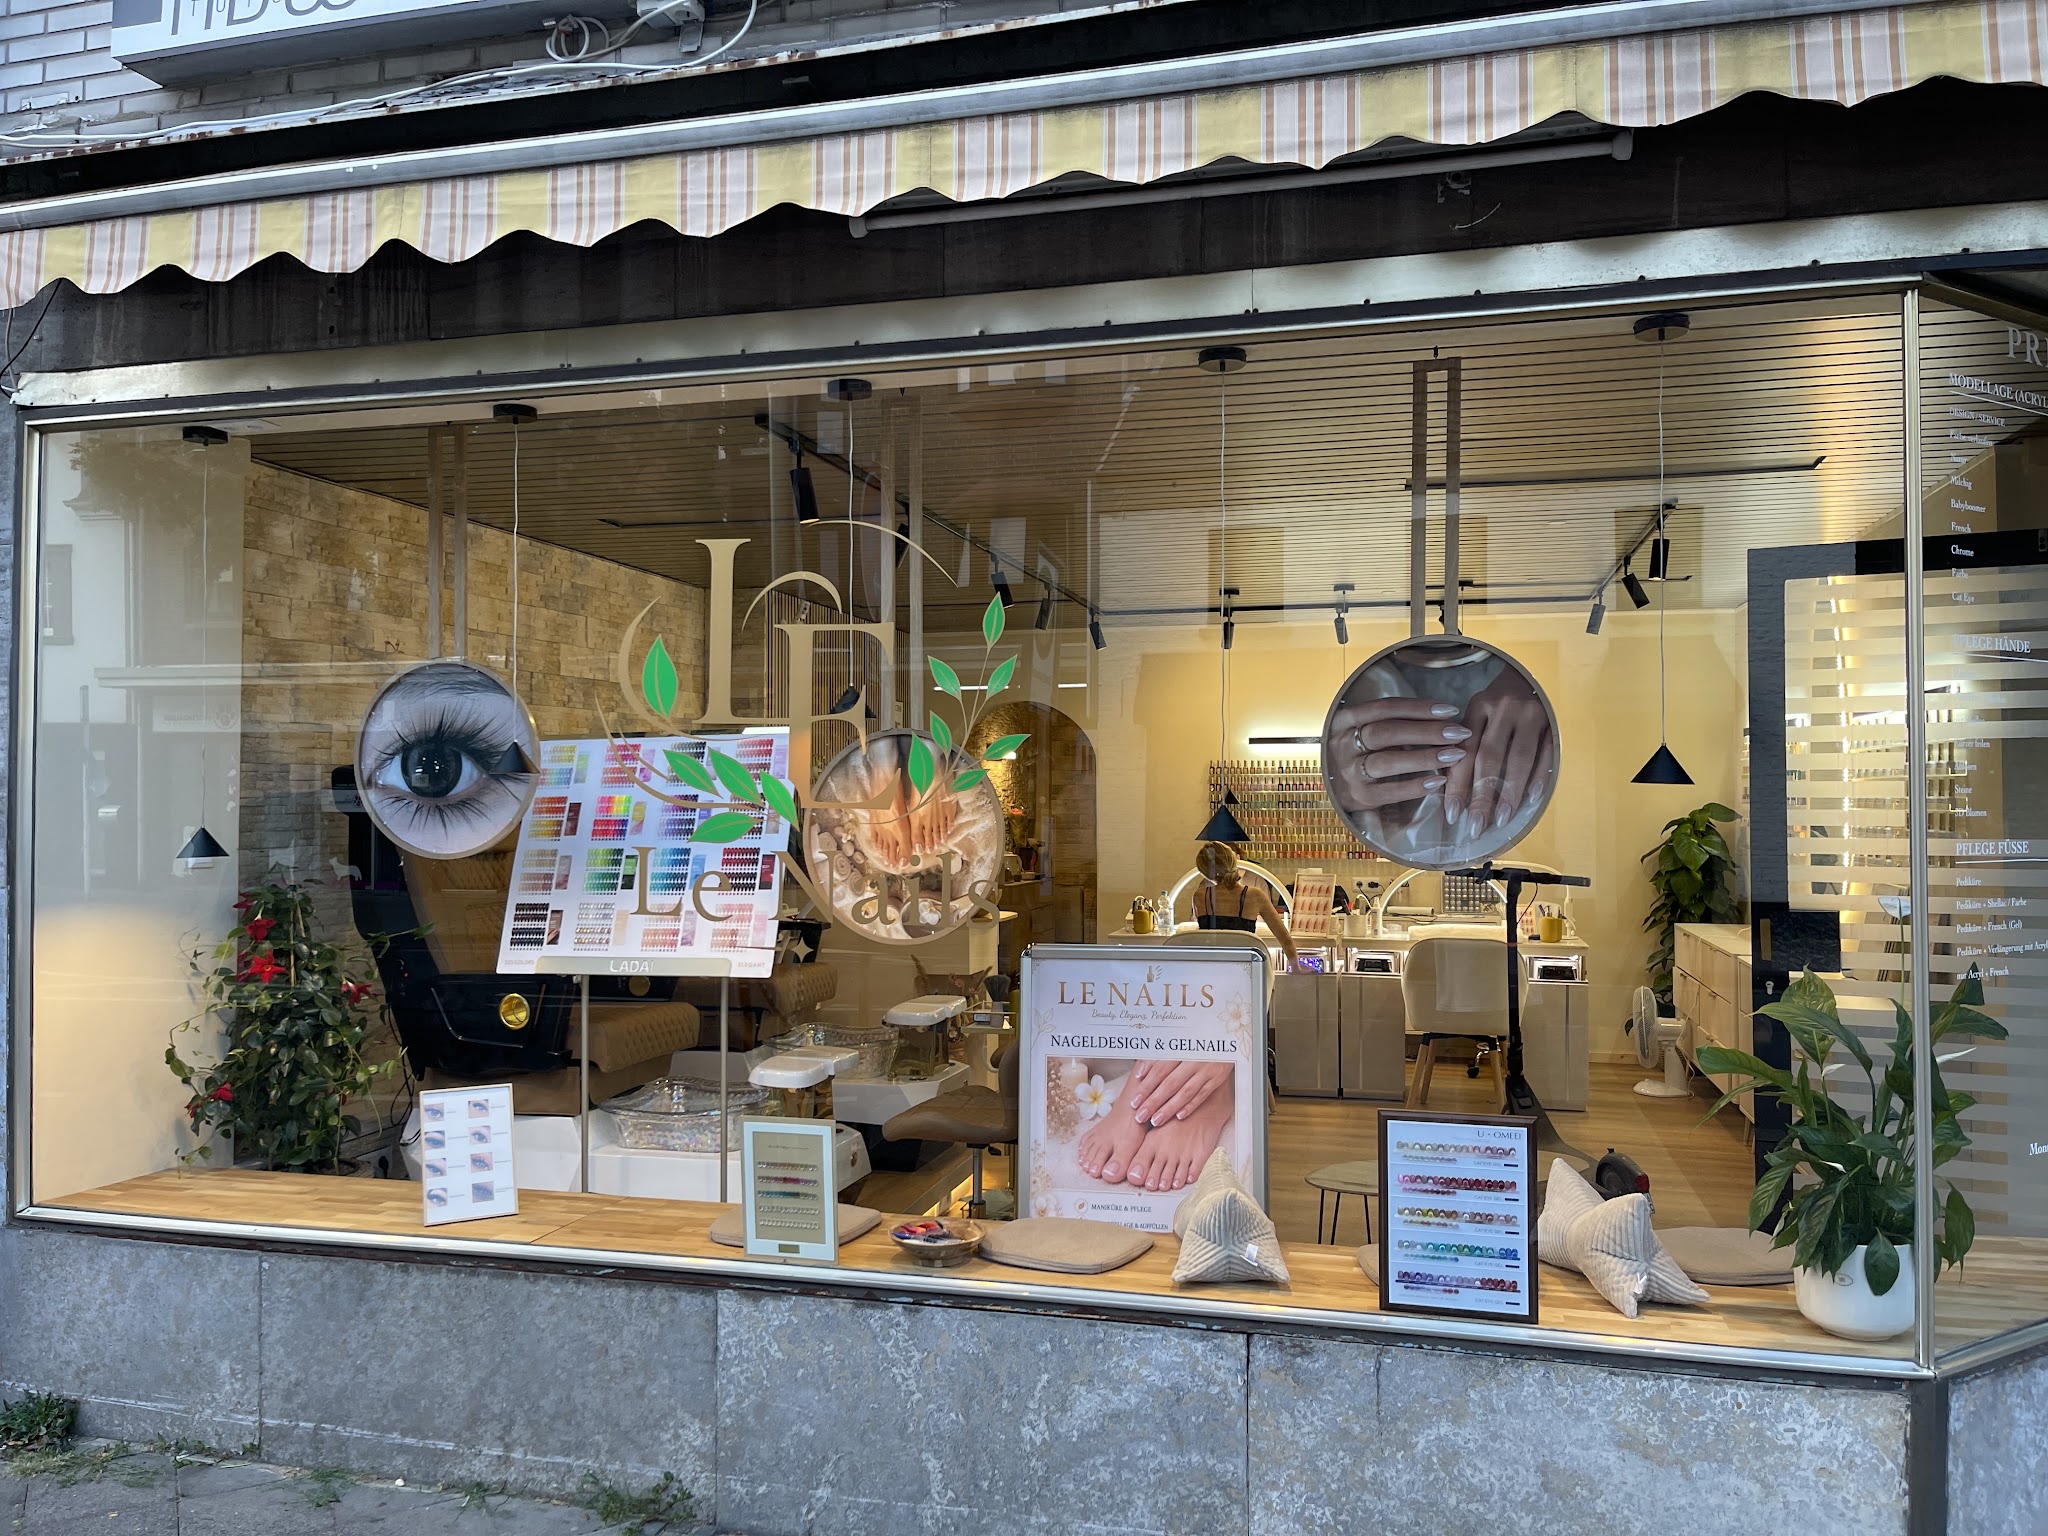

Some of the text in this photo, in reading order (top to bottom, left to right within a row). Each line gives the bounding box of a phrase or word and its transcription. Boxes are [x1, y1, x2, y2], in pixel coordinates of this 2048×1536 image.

[1949, 372, 2014, 400] MODELLAGE
[1950, 407, 1975, 420] DESIGN
[1979, 414, 2006, 427] SERVICE
[1951, 475, 1973, 491] Milchig
[1951, 498, 1986, 512] Babyboomer
[1951, 521, 1972, 534] French
[1951, 544, 1975, 557] Chrome
[1951, 567, 1969, 579] Farbe
[1951, 591, 1975, 604] Cat Eye
[1951, 633, 2031, 654] PFLEGE HÄNDE
[1954, 784, 1973, 794] Steine
[1956, 839, 2029, 856] PFLEGE FÜSSE
[632, 846, 1001, 929] Le Nails
[1956, 876, 1982, 887] Pediküre
[1956, 900, 1982, 910] Pediküre
[1987, 899, 2007, 908] Shellac
[2011, 896, 2027, 907] Farbe
[1956, 923, 1982, 934] Pediküre
[1988, 920, 2007, 931] French
[2008, 919, 2022, 930] (Gel)
[1957, 946, 1982, 957] Pediküre
[1968, 969, 1984, 981] Acryl
[1989, 966, 2009, 977] French
[1058, 981, 1215, 1008] LE NAILS
[1050, 1034, 1237, 1053] NAGELDESIGN & GELNAILS
[1091, 1203, 1122, 1212] MANIKÜRE
[1139, 1222, 1168, 1230] AUFFÜLLEN
